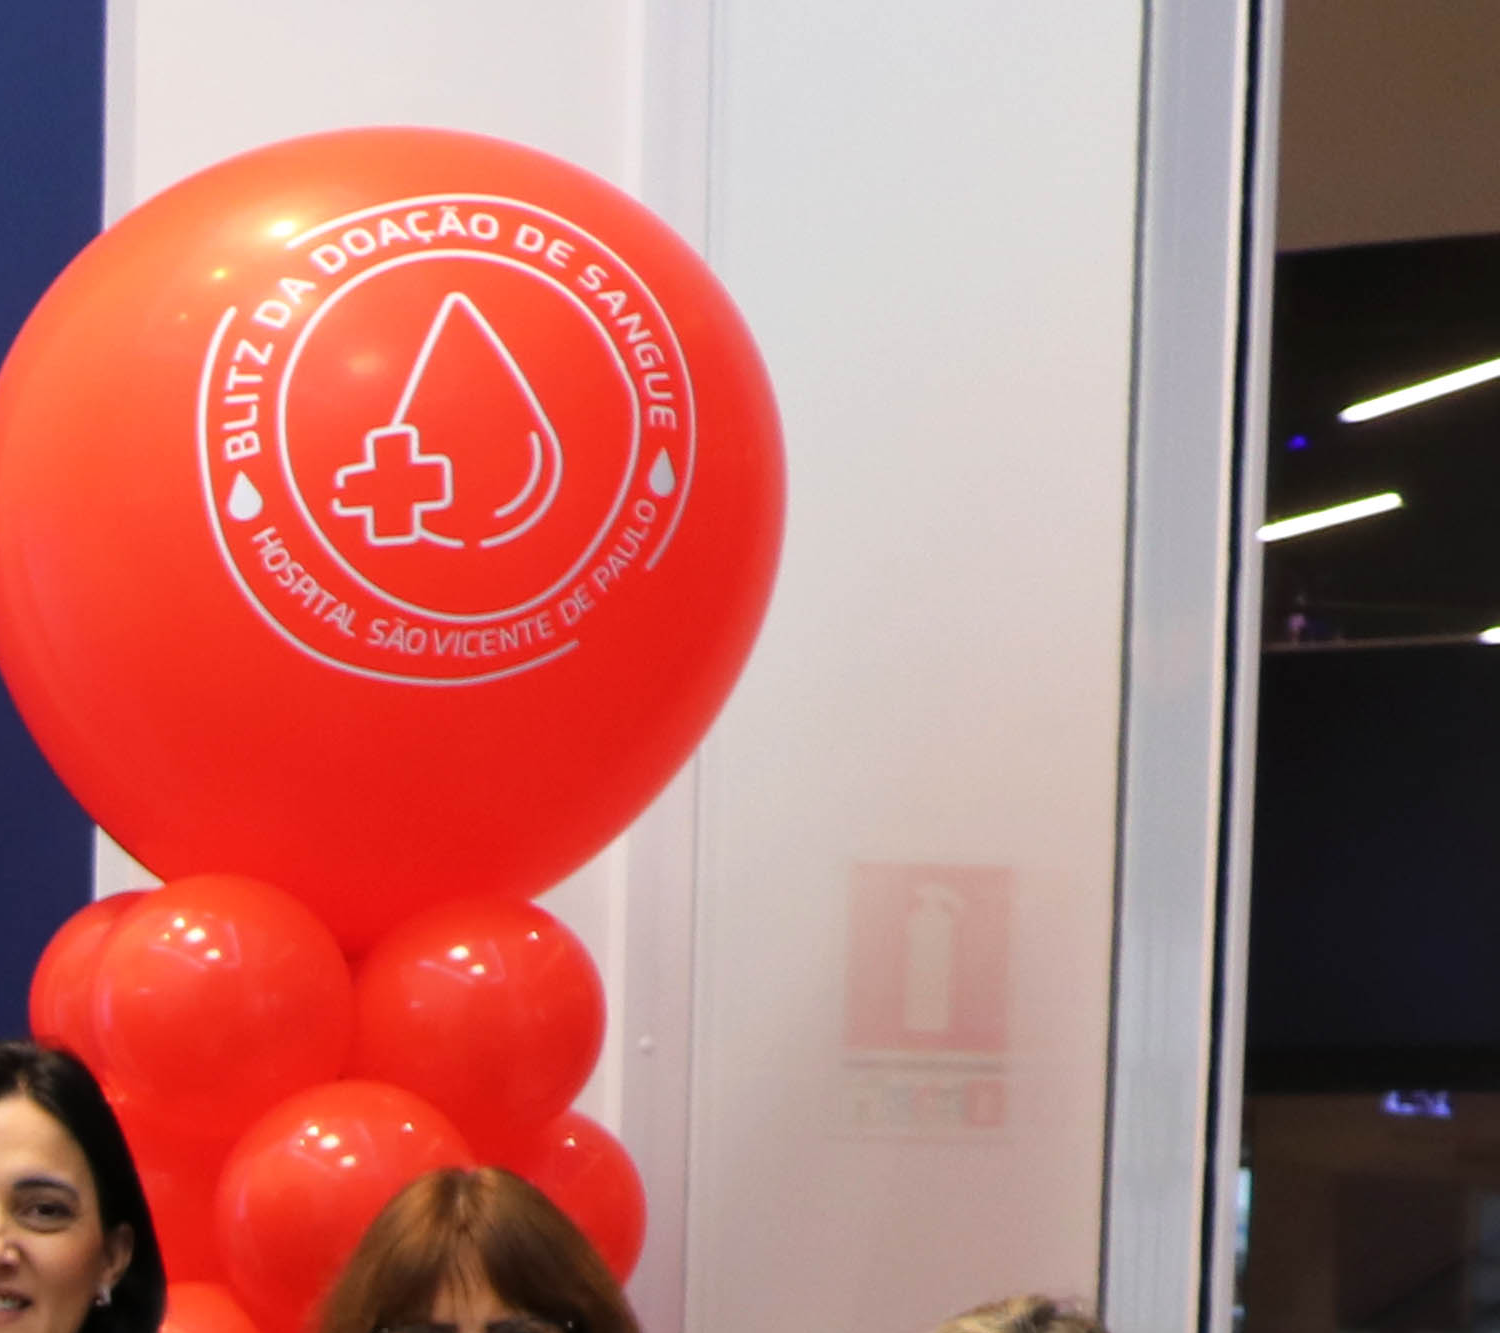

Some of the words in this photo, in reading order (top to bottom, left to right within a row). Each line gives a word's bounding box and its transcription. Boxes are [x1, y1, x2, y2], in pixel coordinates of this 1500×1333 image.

[223, 343, 273, 462] BLITZ
[254, 274, 316, 332] DA
[310, 207, 499, 279] DOAÇÃO
[515, 220, 576, 269] DE
[577, 258, 678, 431] SANGUE
[252, 524, 358, 640] HOSPITAL
[367, 617, 428, 656] SÃO
[432, 617, 556, 659] VICENTE
[560, 587, 596, 629] DE
[593, 499, 657, 592] PAULO
